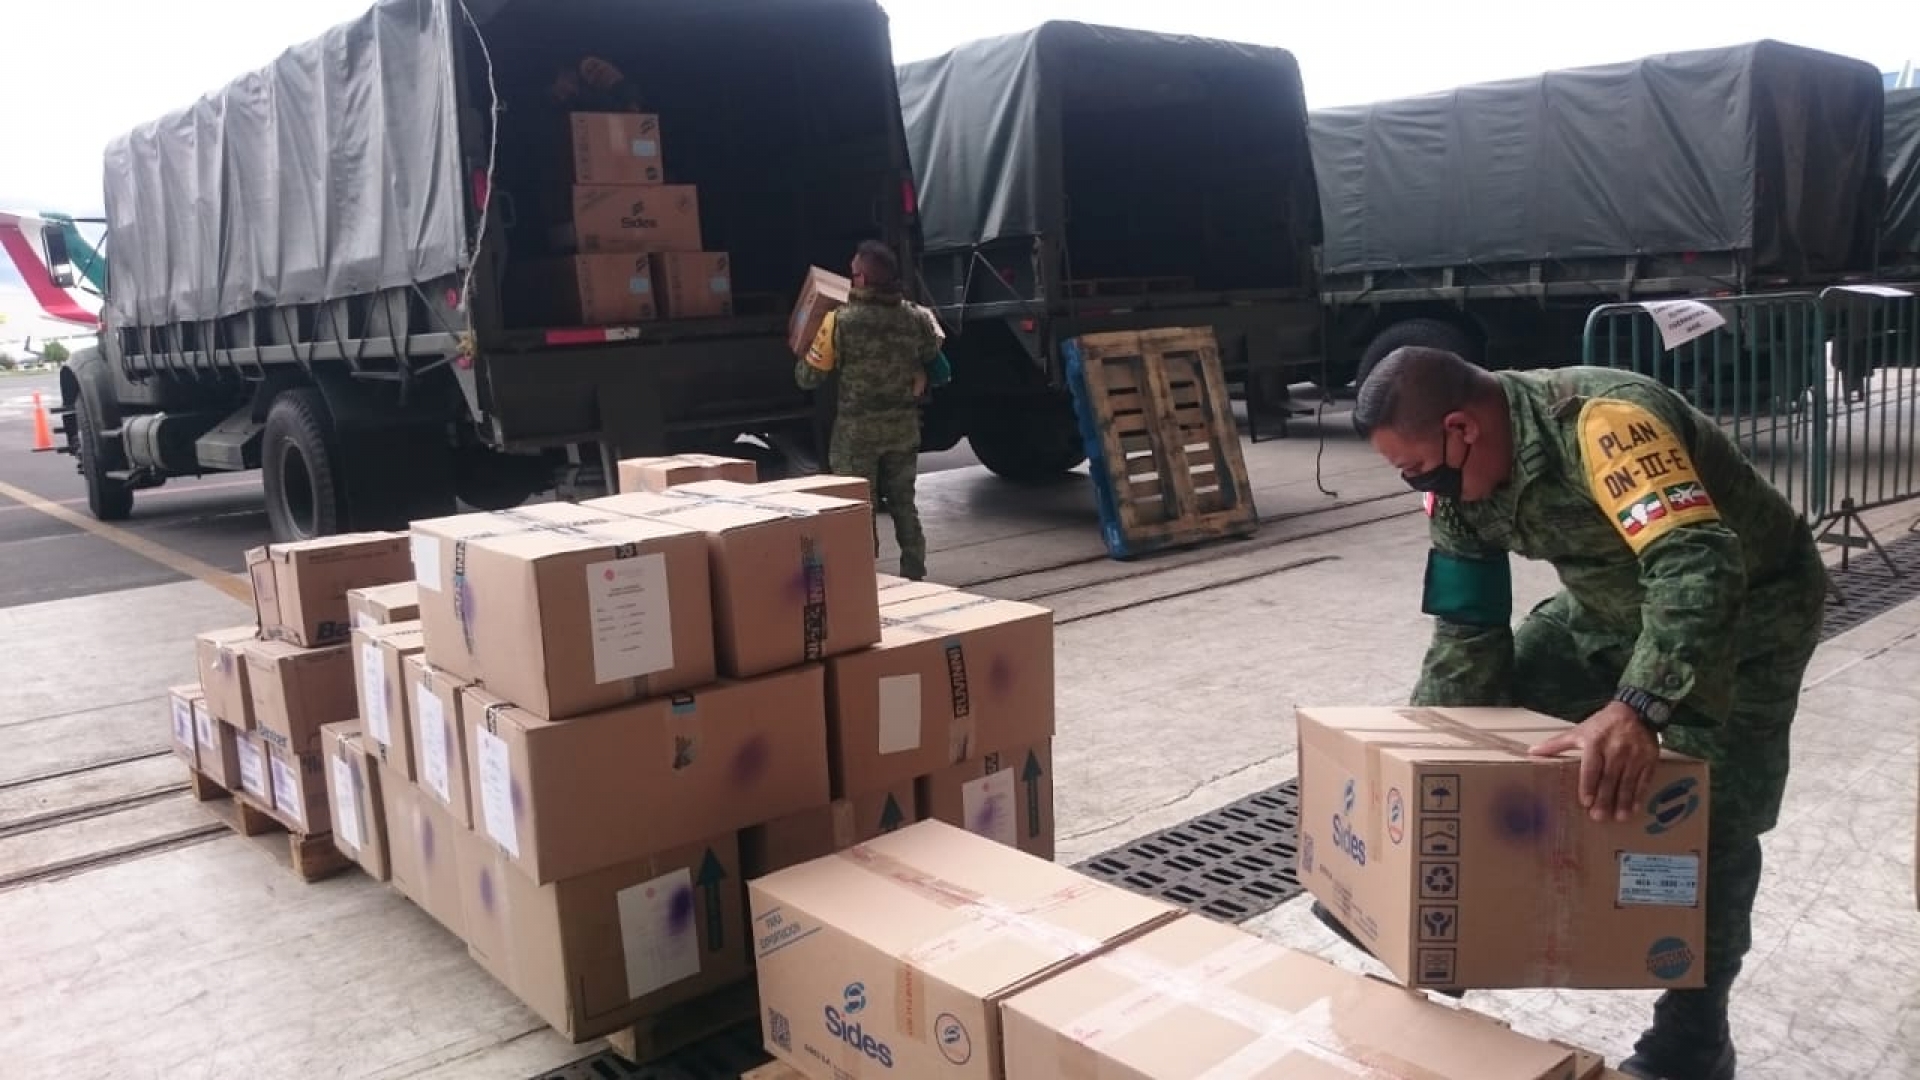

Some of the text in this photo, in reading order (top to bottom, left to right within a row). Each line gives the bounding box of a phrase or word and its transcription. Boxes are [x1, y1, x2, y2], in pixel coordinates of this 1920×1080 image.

[1599, 420, 1659, 460] PLAN
[1332, 813, 1366, 867] Sides
[824, 1004, 893, 1069] Sides
